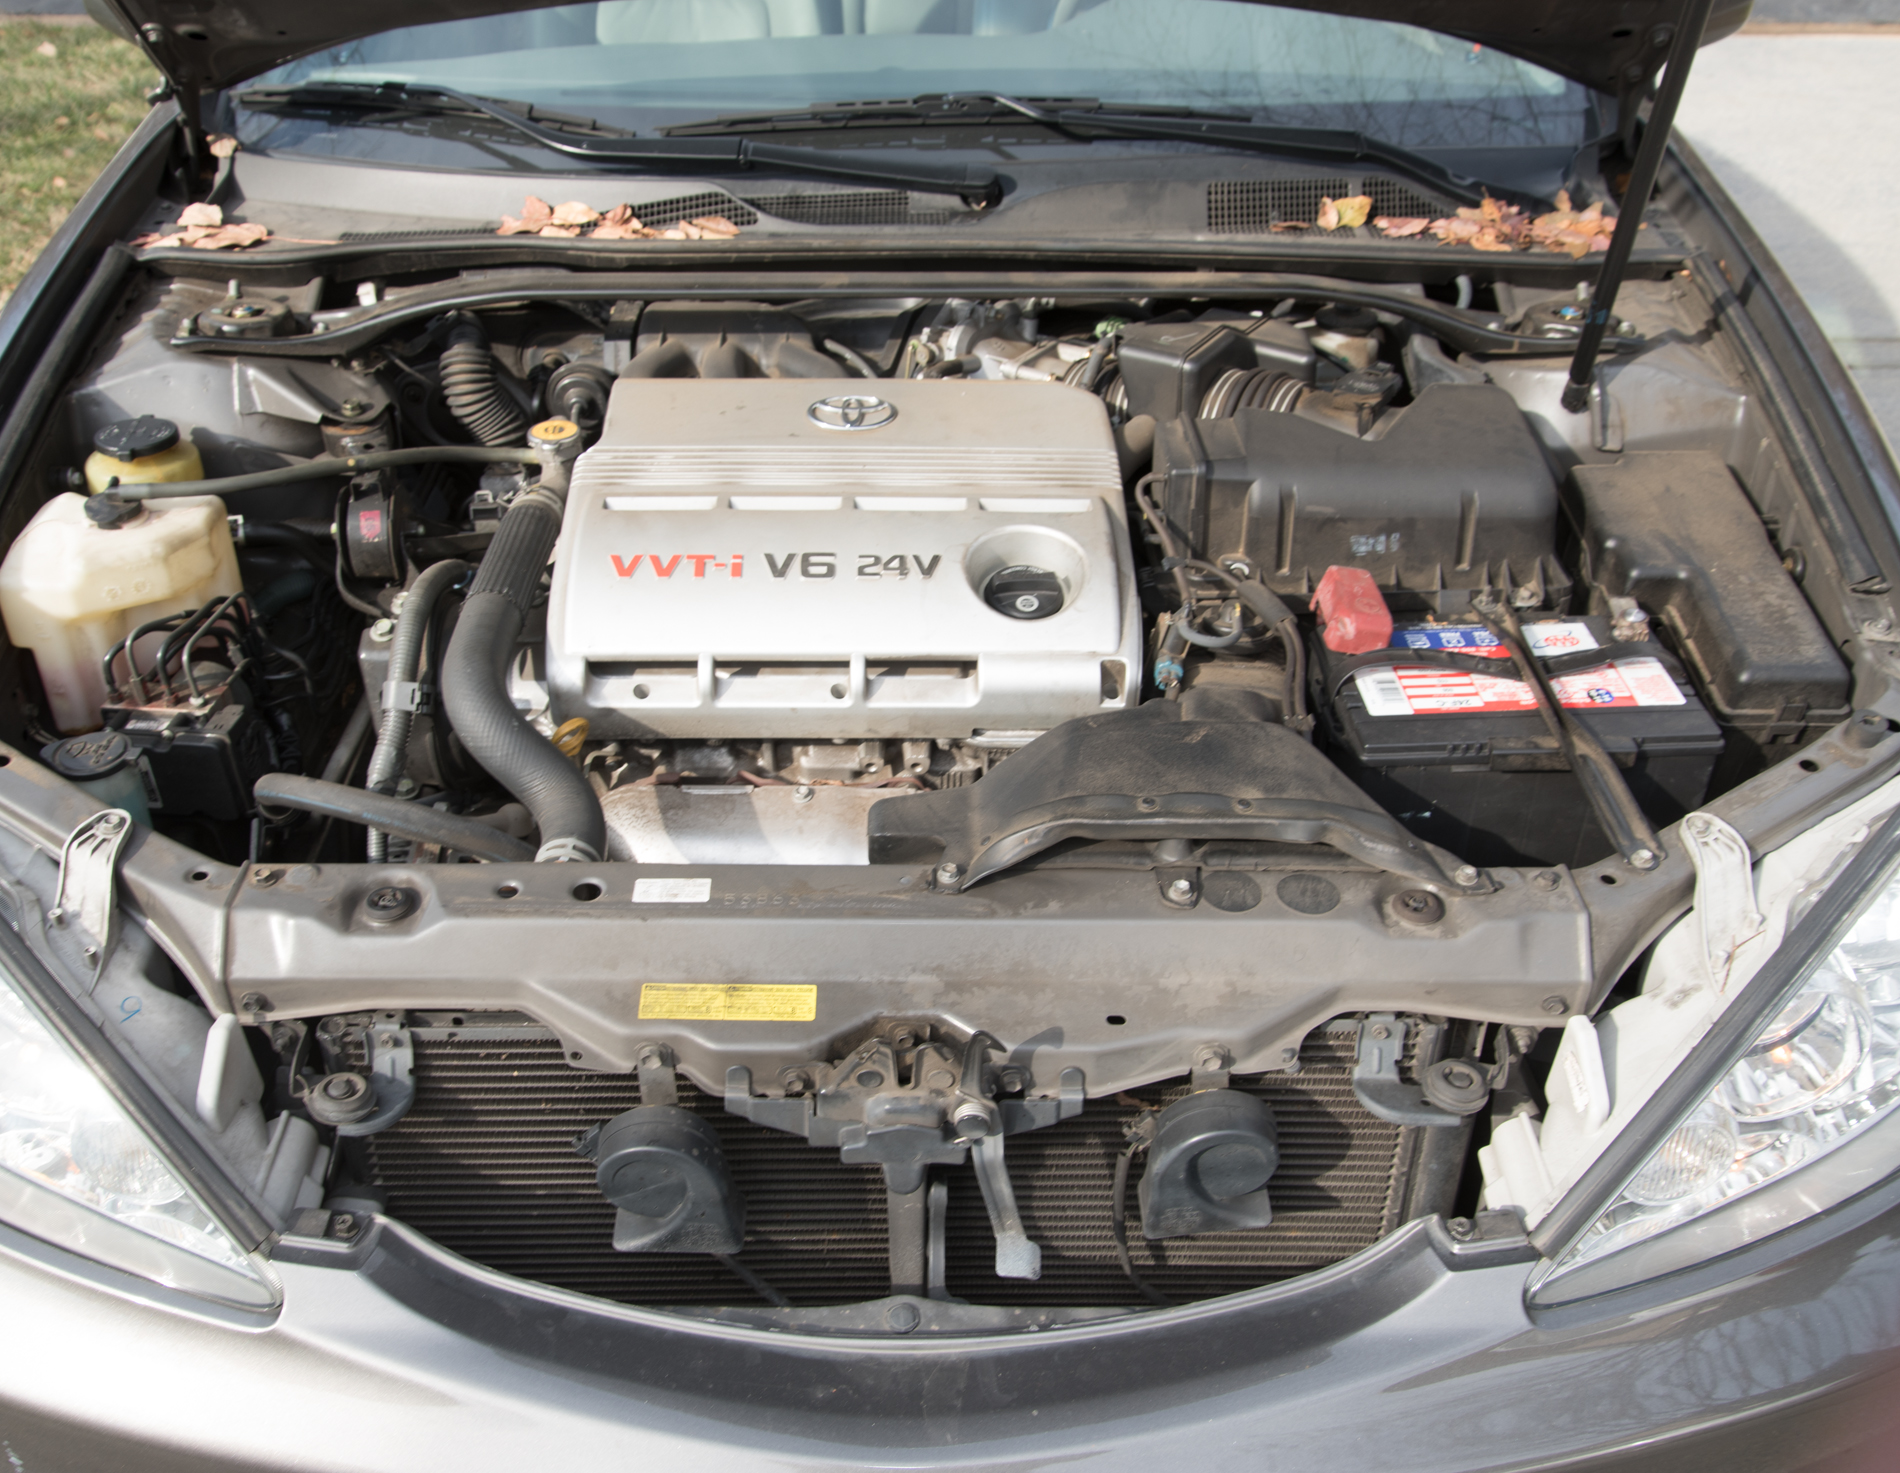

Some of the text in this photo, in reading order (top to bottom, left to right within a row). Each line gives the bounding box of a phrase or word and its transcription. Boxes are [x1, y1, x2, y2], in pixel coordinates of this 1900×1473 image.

[609, 552, 943, 580] VVT-i V6 24V
